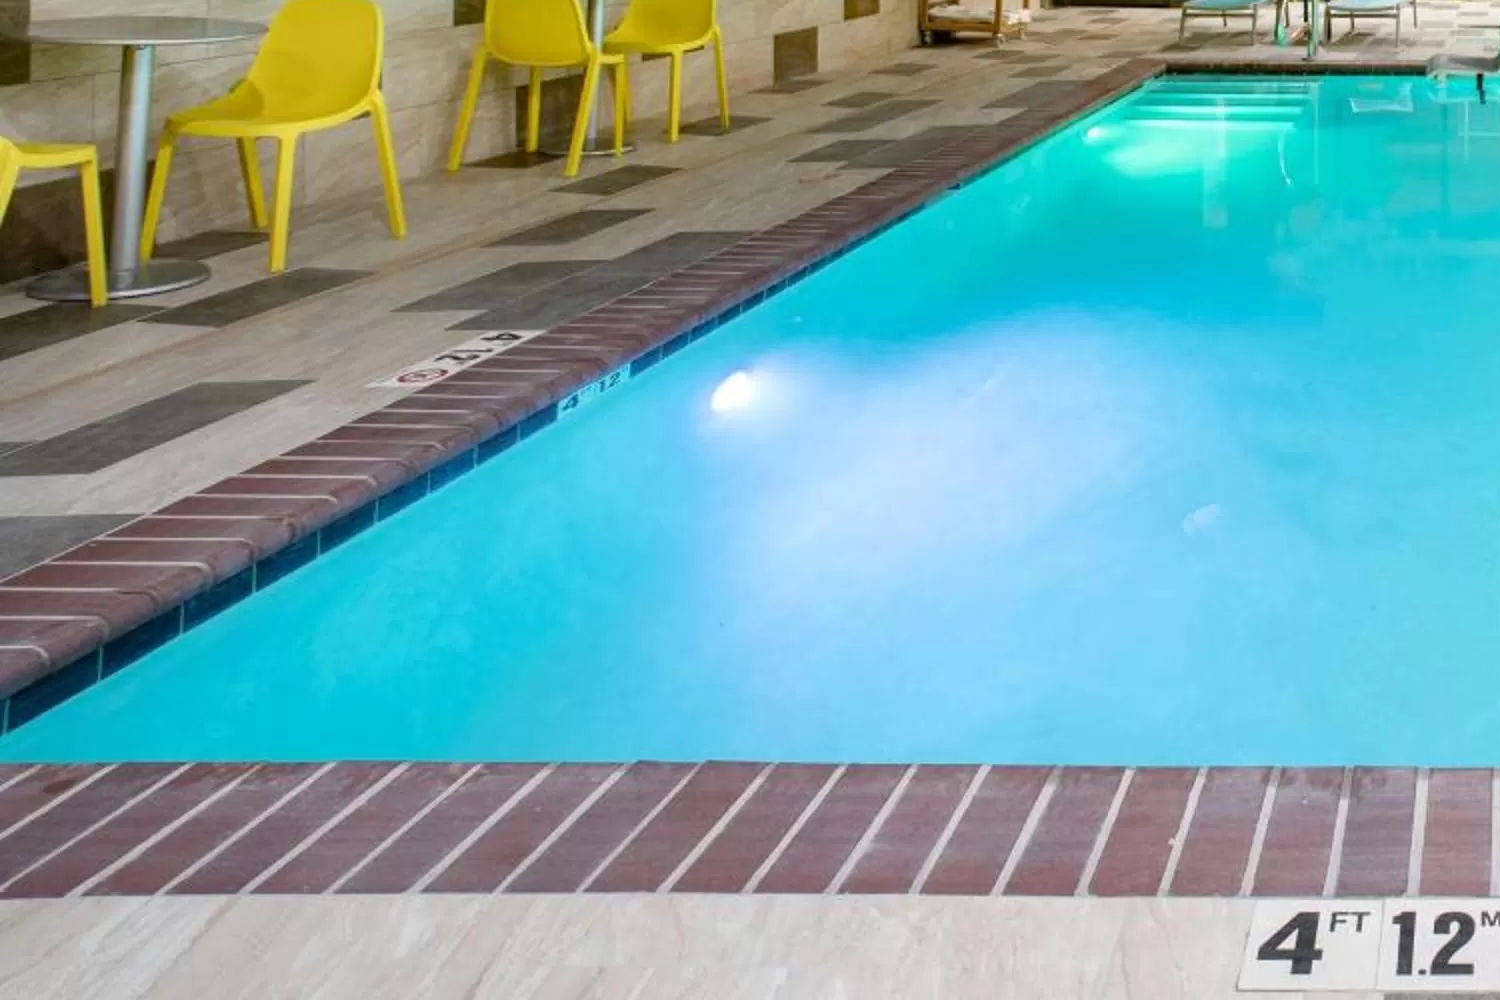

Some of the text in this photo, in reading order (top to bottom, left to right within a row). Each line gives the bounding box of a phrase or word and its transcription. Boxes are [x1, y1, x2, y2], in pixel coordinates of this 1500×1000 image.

[1256, 911, 1323, 975] 4
[1329, 911, 1371, 933] FT
[1392, 911, 1476, 976] 1.2
